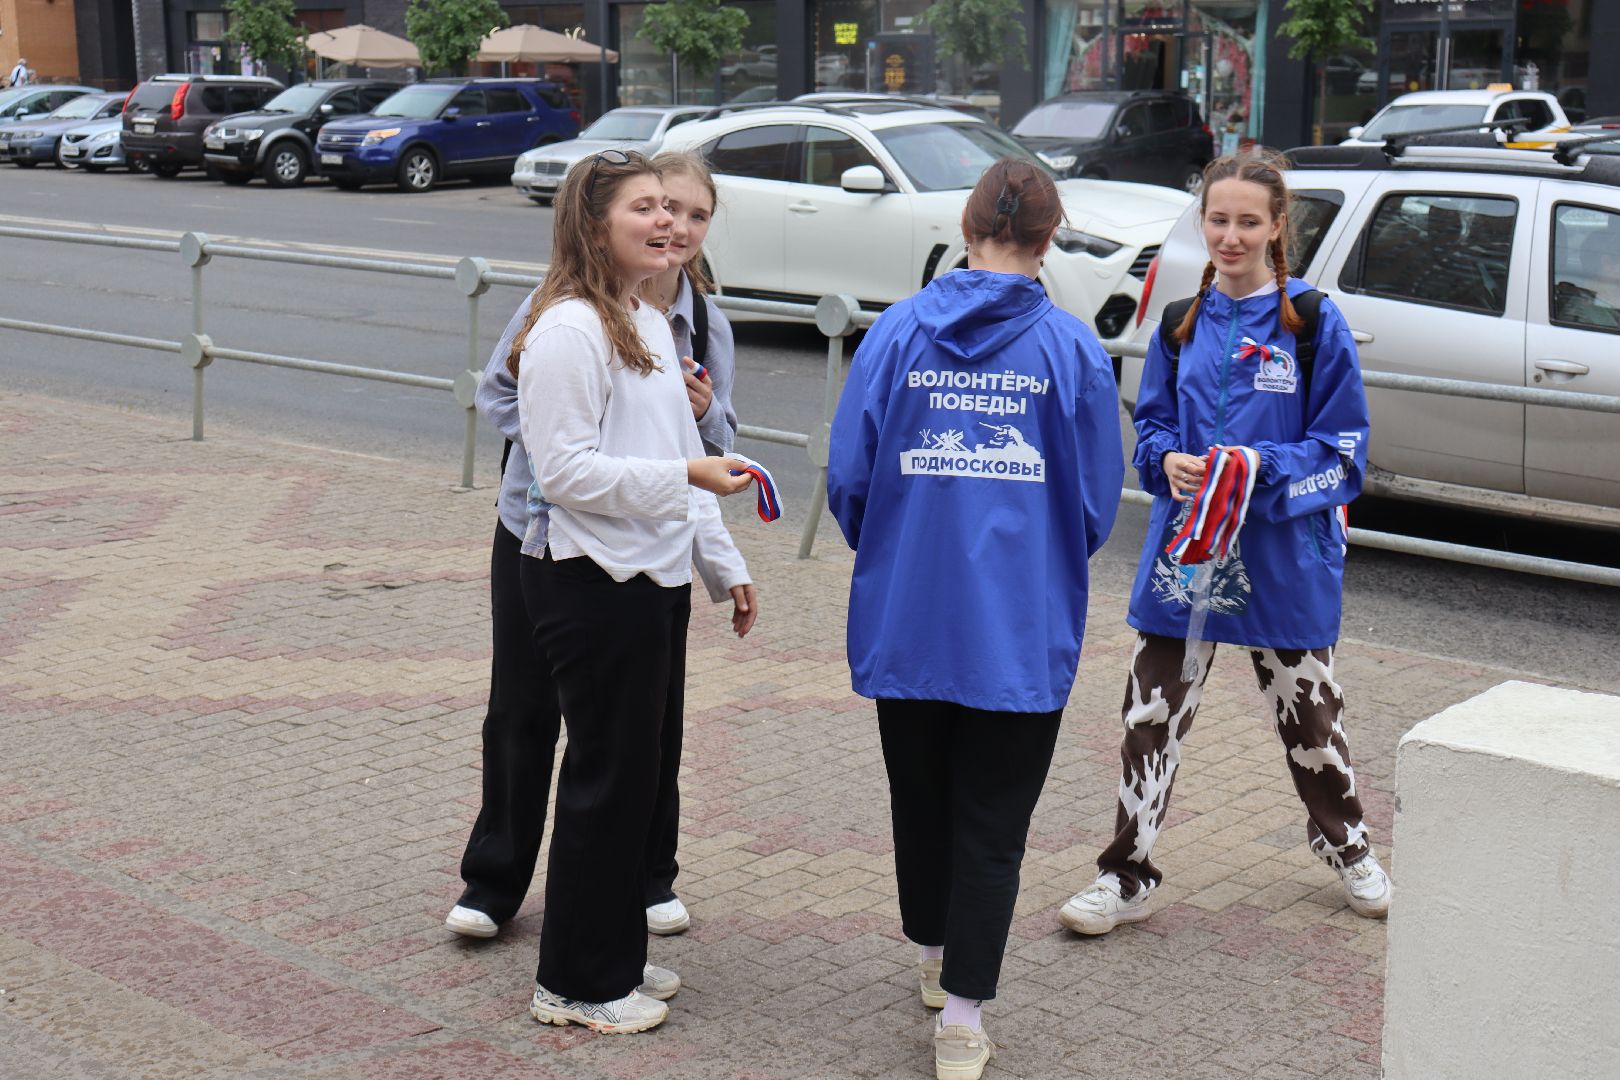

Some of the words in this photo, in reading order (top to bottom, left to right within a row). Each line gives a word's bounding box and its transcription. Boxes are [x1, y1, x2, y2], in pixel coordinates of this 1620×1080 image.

[908, 369, 1049, 394] ВОЛОНТЁРЫ
[929, 392, 1027, 416] ПОБЕДЫ
[911, 456, 1041, 477] ПОДМОСКОВЬЕ
